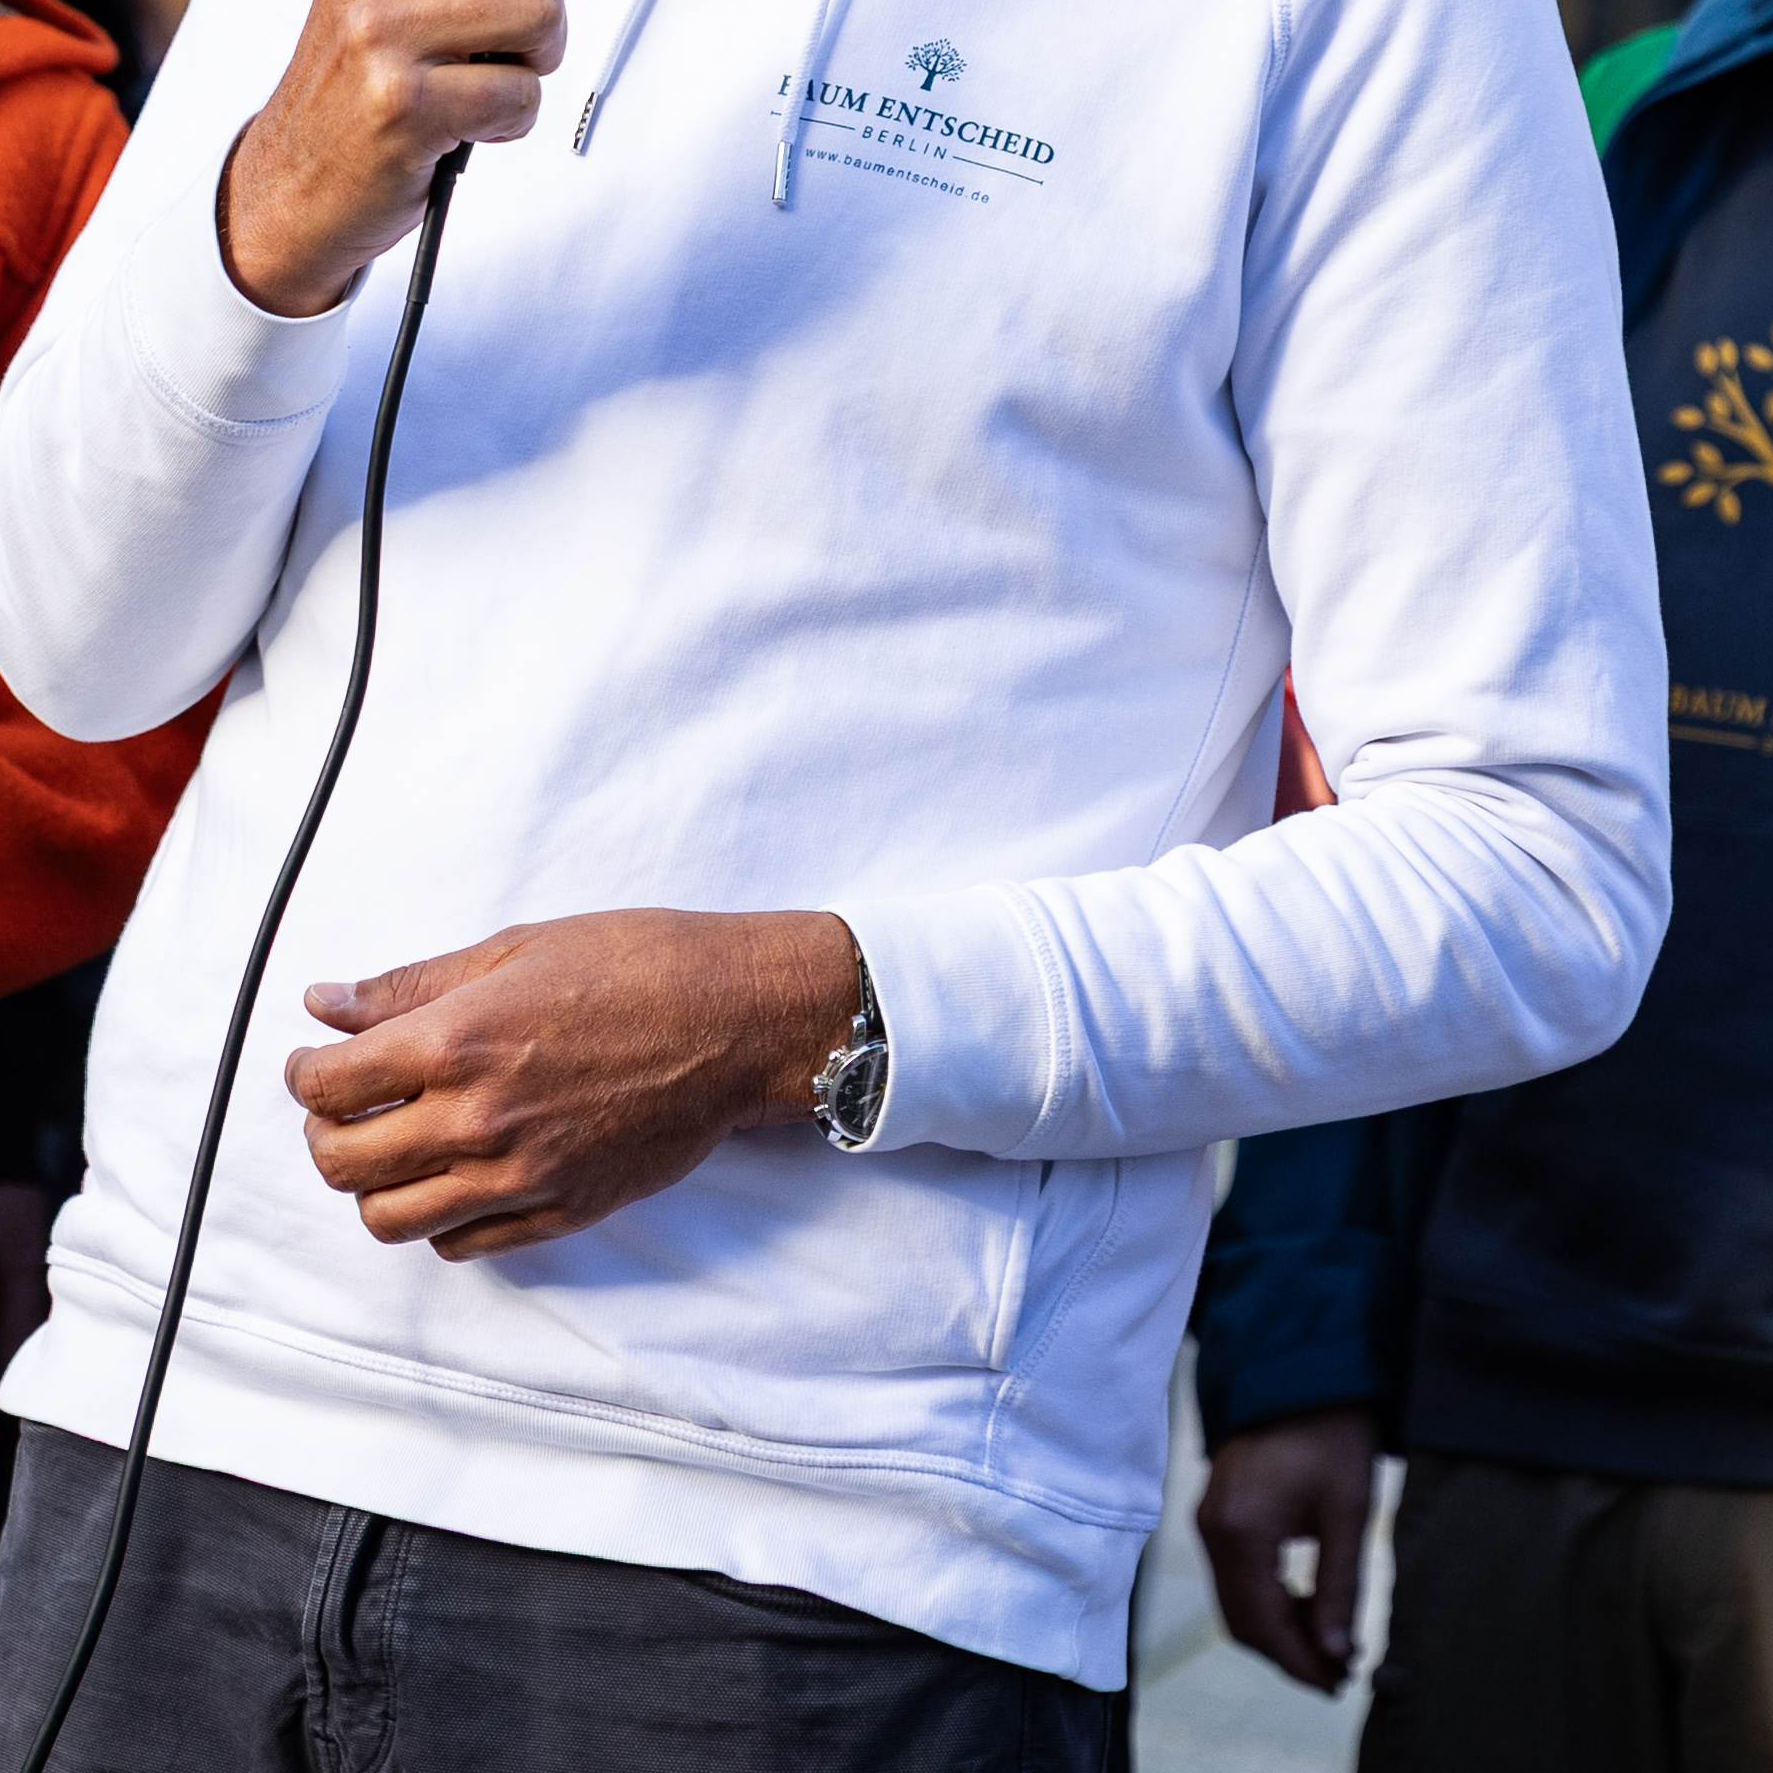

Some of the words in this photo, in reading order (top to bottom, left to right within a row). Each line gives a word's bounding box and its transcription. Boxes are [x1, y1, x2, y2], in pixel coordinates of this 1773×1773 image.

[861, 125, 949, 161] BERLIN
[875, 96, 1056, 165] ENTSCHEID
[804, 146, 991, 205] www.baumentscheid.de
